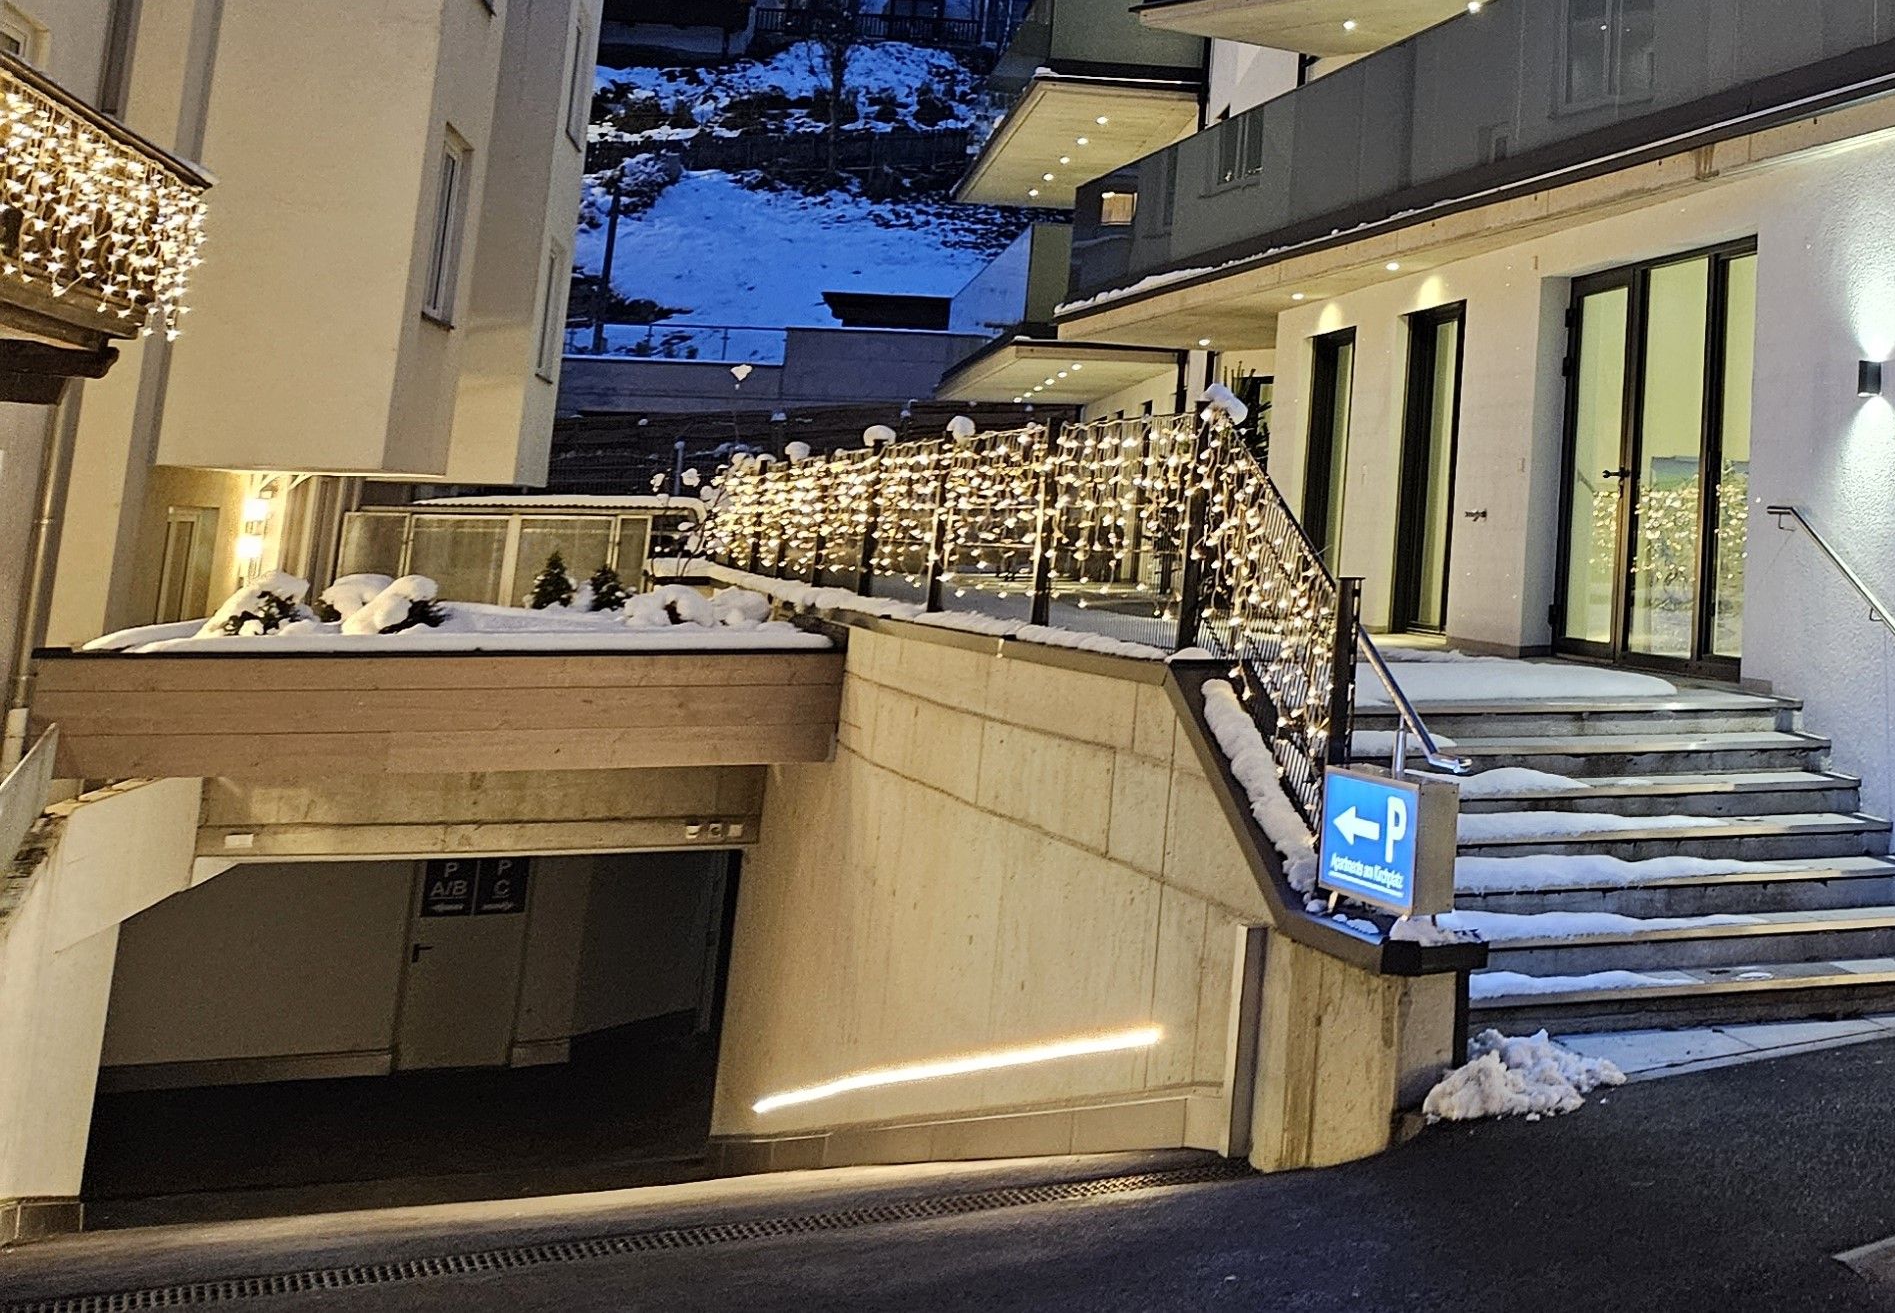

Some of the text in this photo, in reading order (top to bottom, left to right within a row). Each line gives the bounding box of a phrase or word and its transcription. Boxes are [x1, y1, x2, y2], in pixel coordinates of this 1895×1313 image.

[1384, 795, 1408, 864] P
[444, 861, 460, 878] P
[497, 859, 513, 876] P
[430, 879, 468, 897] A/B
[494, 879, 511, 895] C
